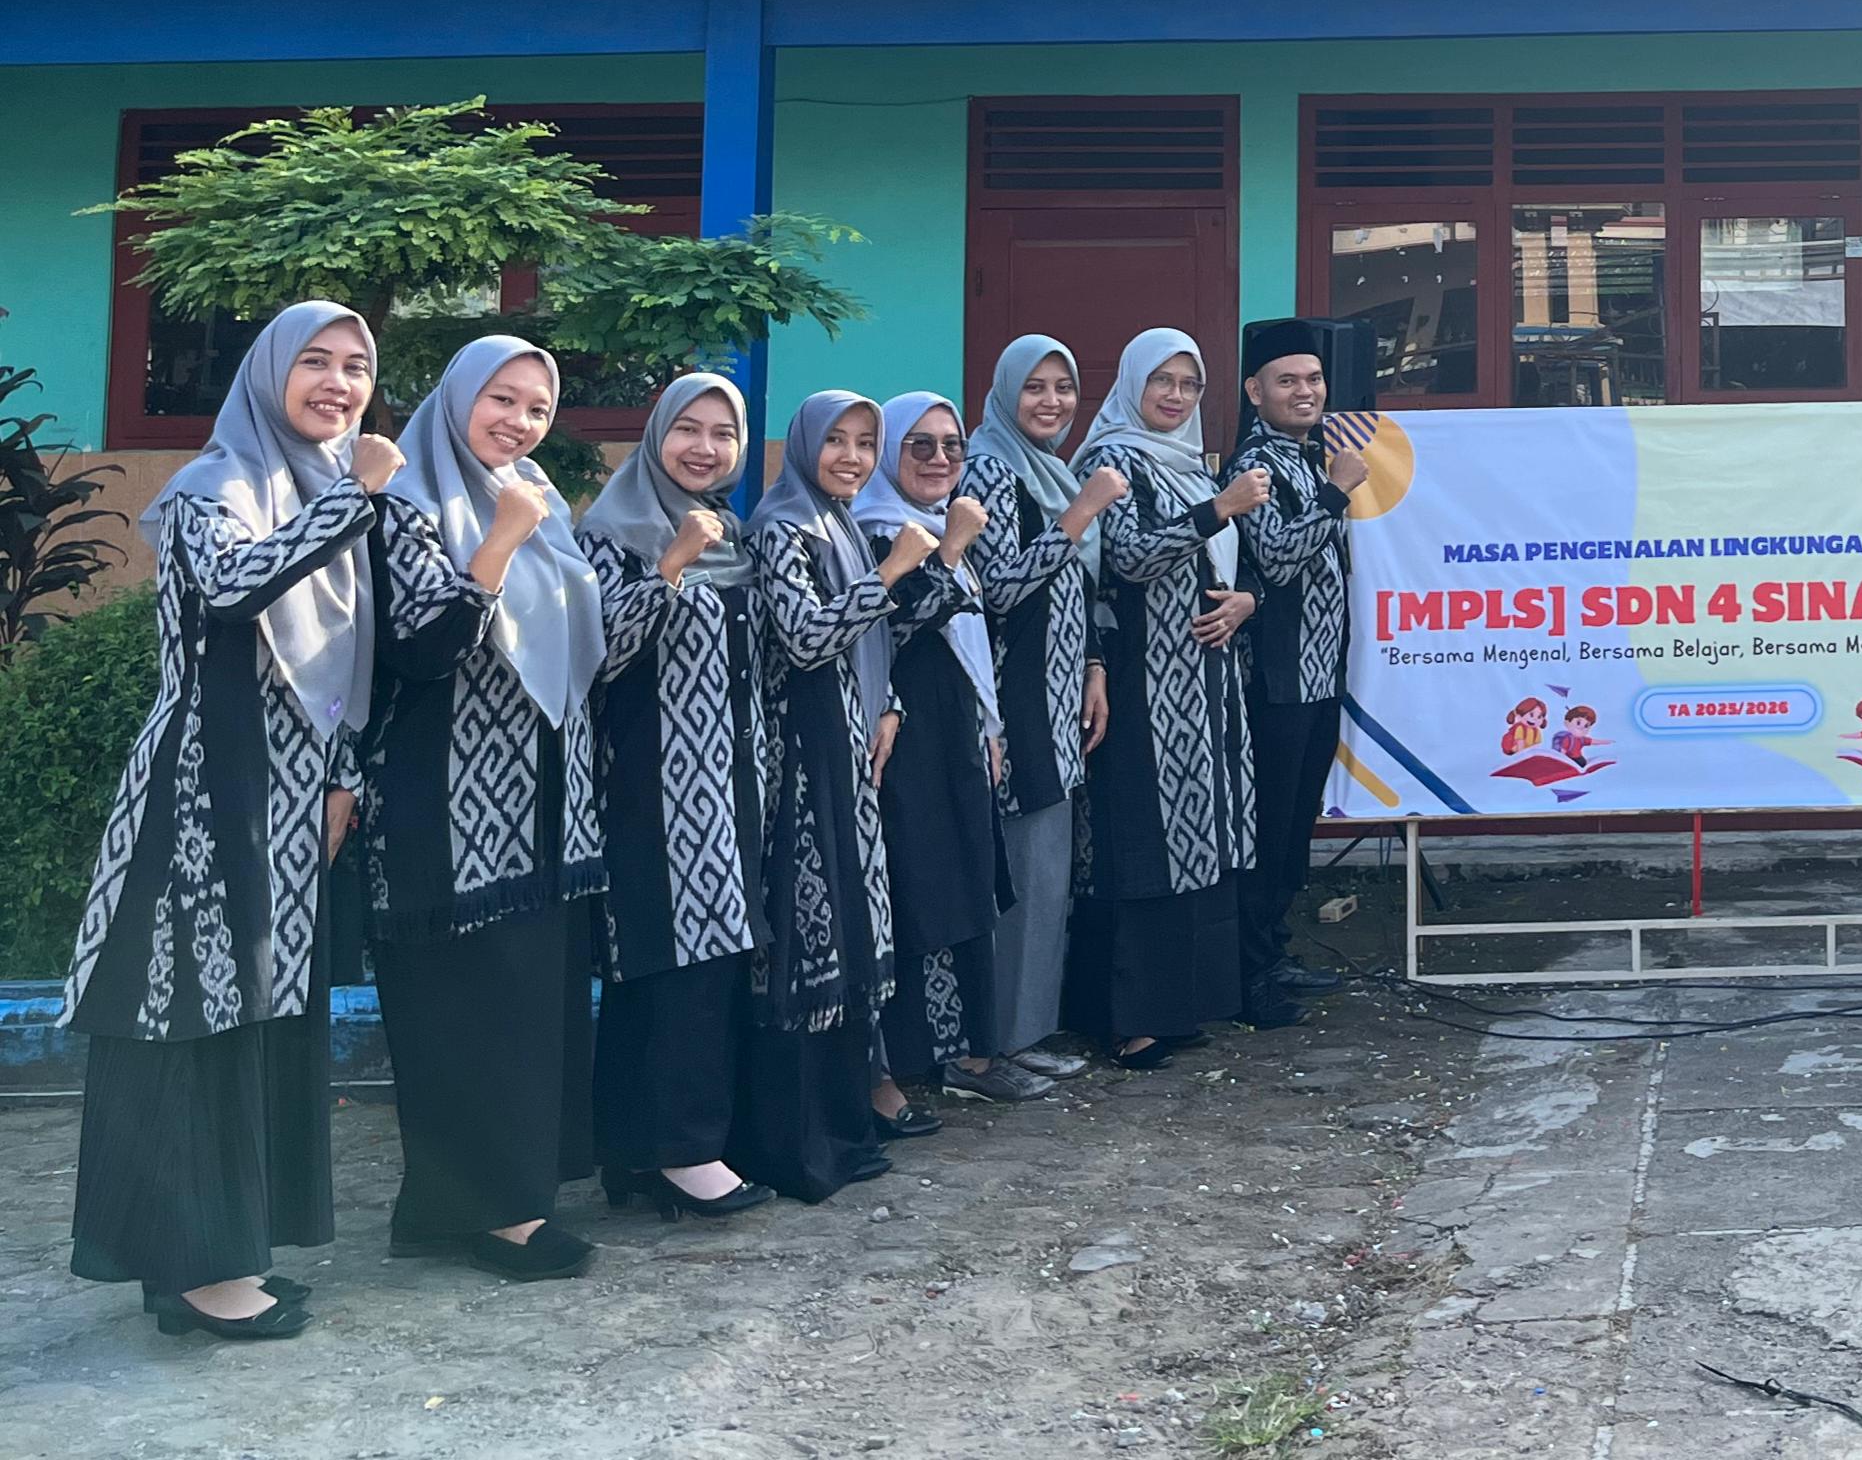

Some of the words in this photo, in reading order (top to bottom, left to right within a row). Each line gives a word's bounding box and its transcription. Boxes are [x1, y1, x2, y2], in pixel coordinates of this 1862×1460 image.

[1443, 543, 1520, 564] MASA
[1525, 538, 1705, 562] PENGENALAN
[1376, 586, 1566, 642] [MPLS]
[1581, 585, 1696, 628] SDN
[1707, 583, 1742, 623] 4
[1483, 642, 1572, 670] Mengenal,
[1580, 641, 1664, 660] Bersama
[1673, 637, 1744, 666] Belajar,
[1753, 636, 1837, 656] Bersama
[1668, 703, 1691, 717] TA
[1695, 701, 1789, 716] 2025/2026
